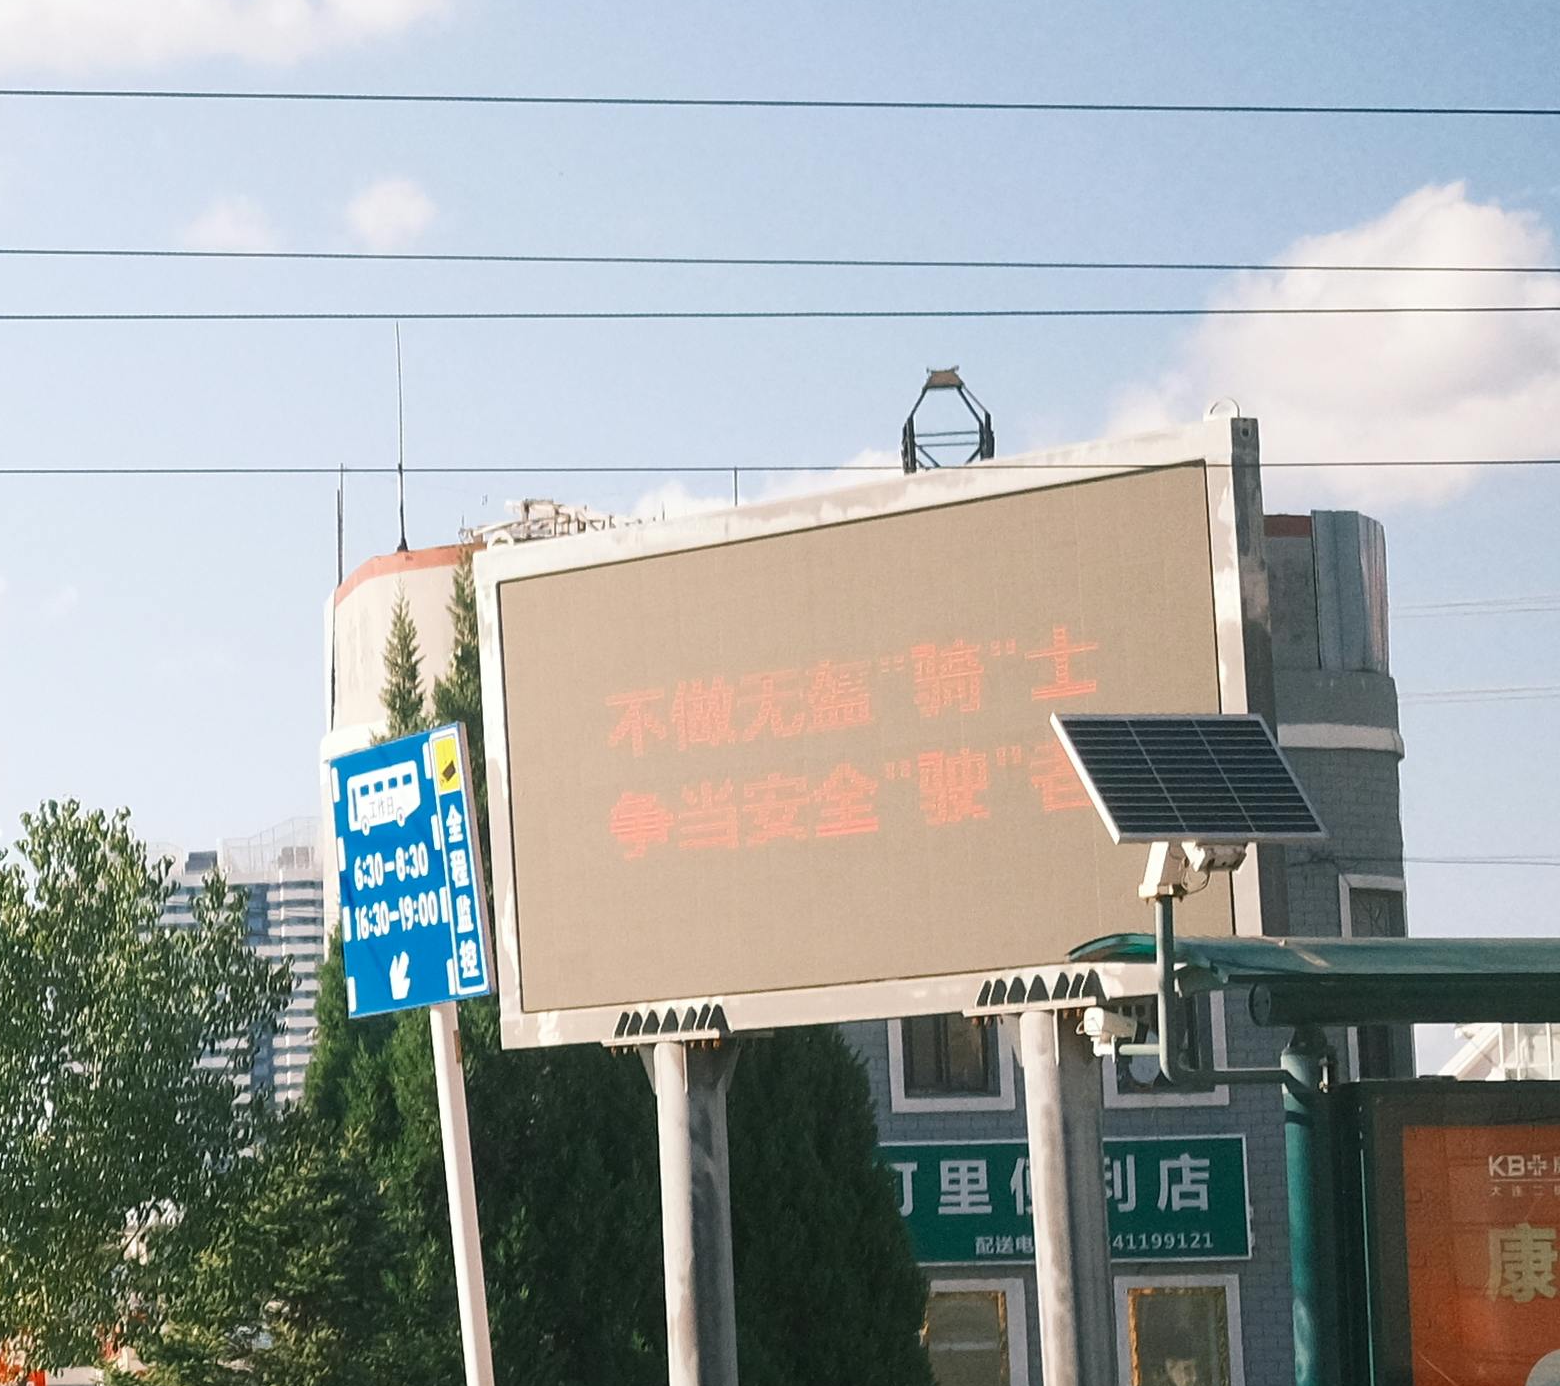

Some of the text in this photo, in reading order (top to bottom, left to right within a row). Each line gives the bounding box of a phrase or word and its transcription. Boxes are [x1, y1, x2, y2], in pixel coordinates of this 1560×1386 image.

[368, 796, 395, 819] 工作日
[353, 841, 430, 892] 6:30-8:30
[446, 804, 481, 980] 全程监控
[354, 889, 439, 943] 16:30-19:00
